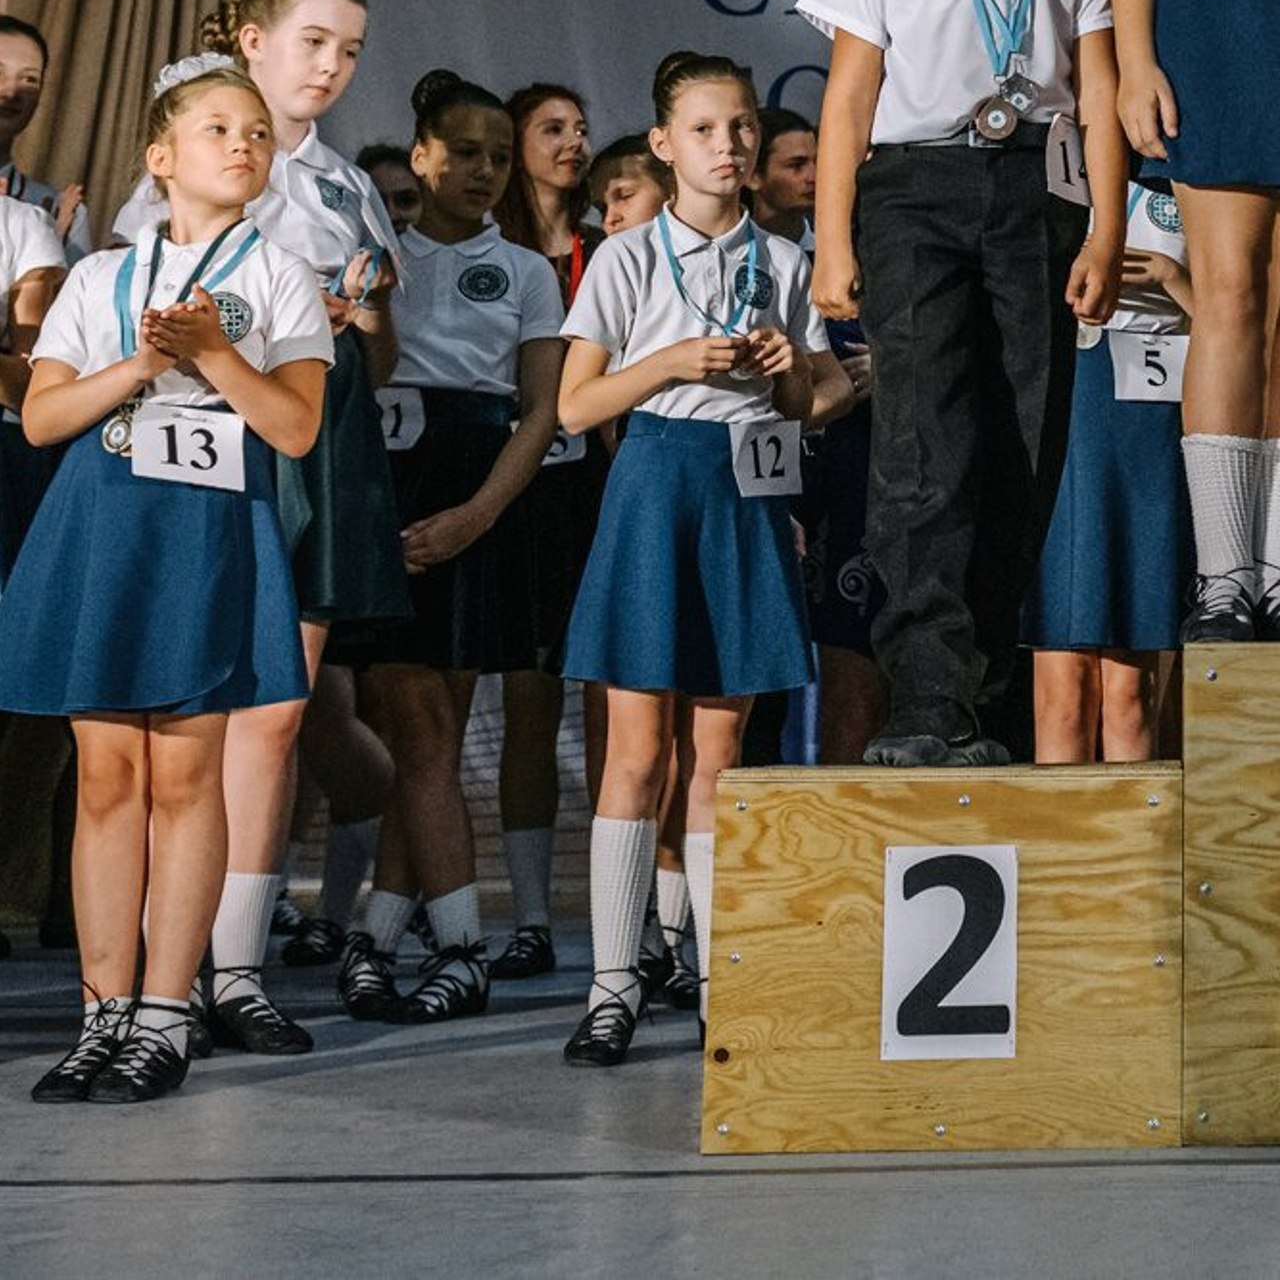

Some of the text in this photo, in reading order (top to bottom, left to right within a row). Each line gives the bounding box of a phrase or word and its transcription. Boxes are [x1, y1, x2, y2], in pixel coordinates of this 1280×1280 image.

[1145, 350, 1168, 387] 5
[158, 424, 218, 471] 13
[750, 435, 785, 479] 12
[896, 854, 1010, 1036] 2
